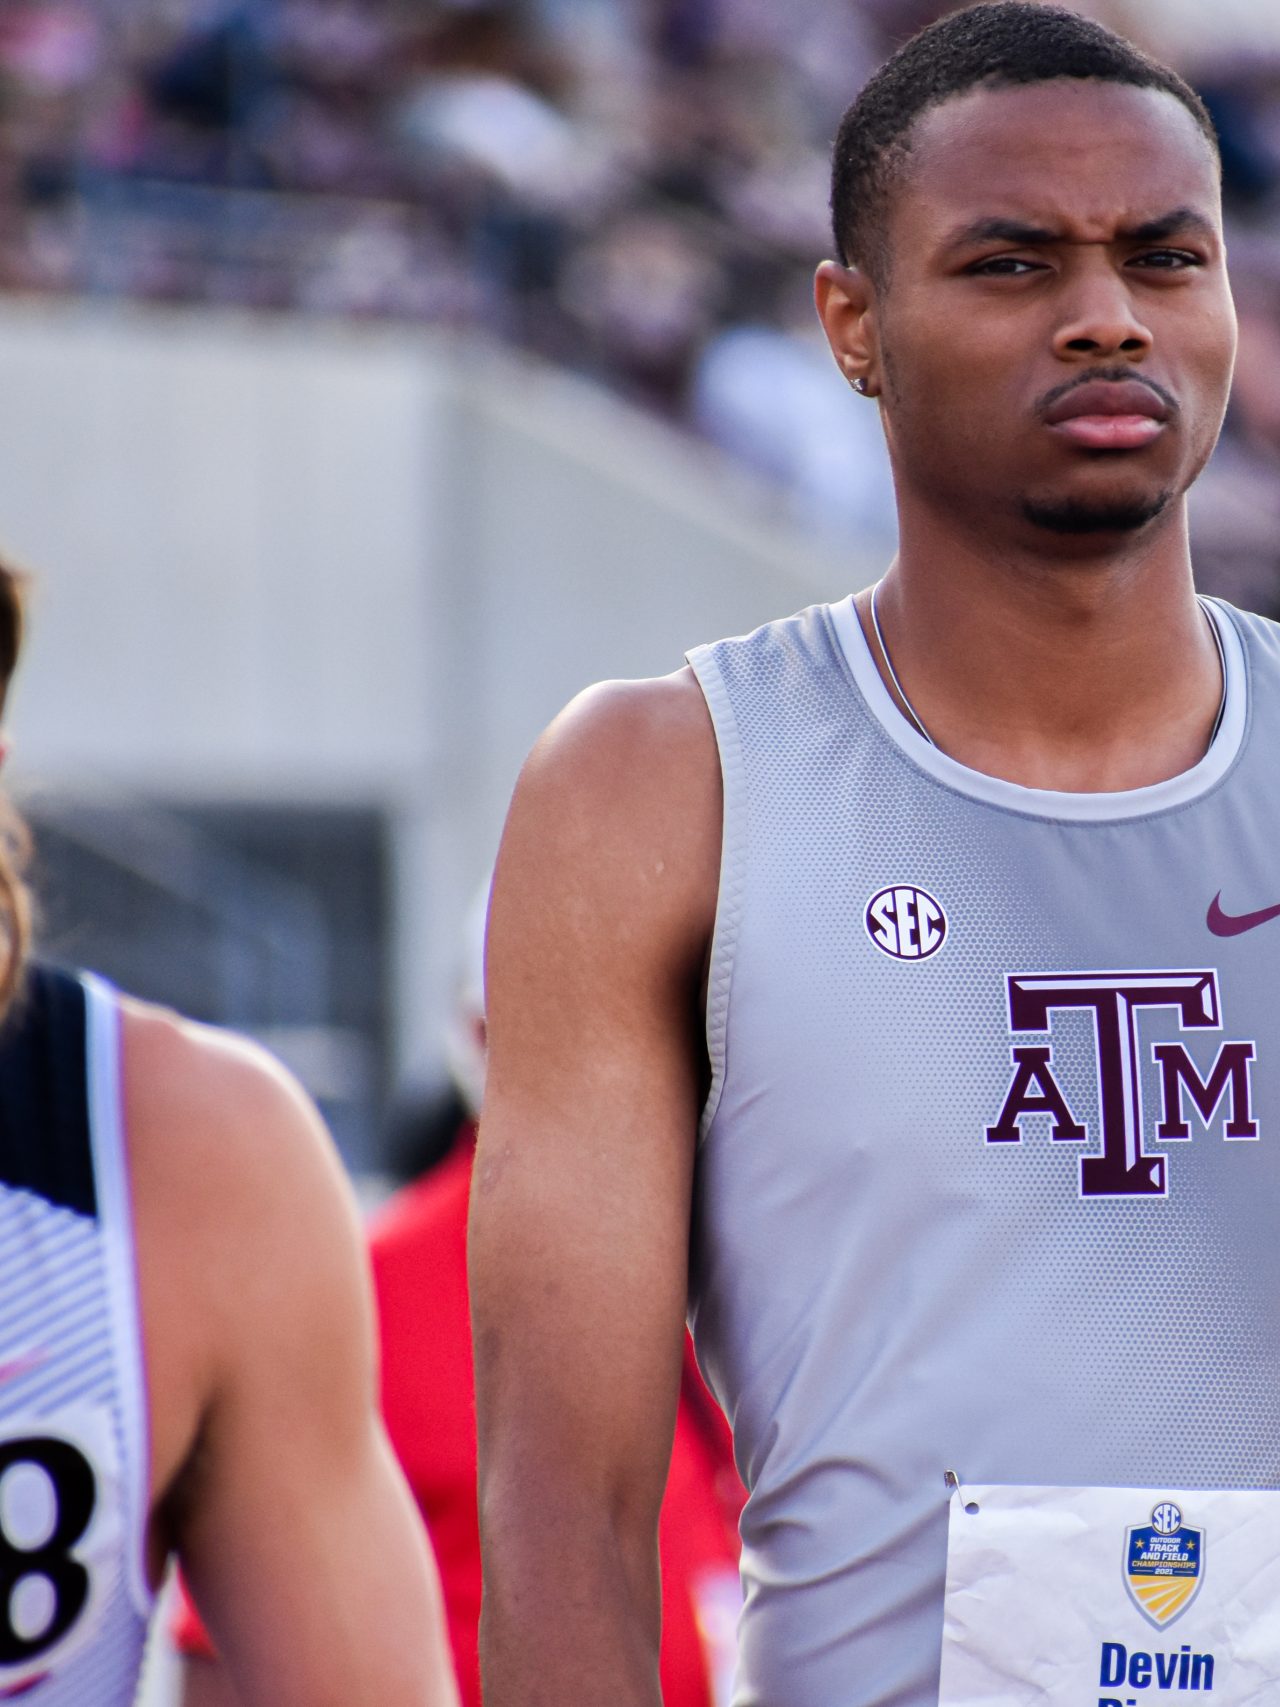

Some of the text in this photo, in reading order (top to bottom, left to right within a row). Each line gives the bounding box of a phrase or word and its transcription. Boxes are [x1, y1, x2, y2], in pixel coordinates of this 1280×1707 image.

[868, 887, 943, 958] SEC
[1152, 1503, 1181, 1534] SEC
[1140, 1552, 1189, 1561] AND FIELD
[1149, 1543, 1180, 1552] TRACK
[1131, 1560, 1197, 1569] CHAMPIONSHIPS
[1099, 1642, 1215, 1690] Devin
